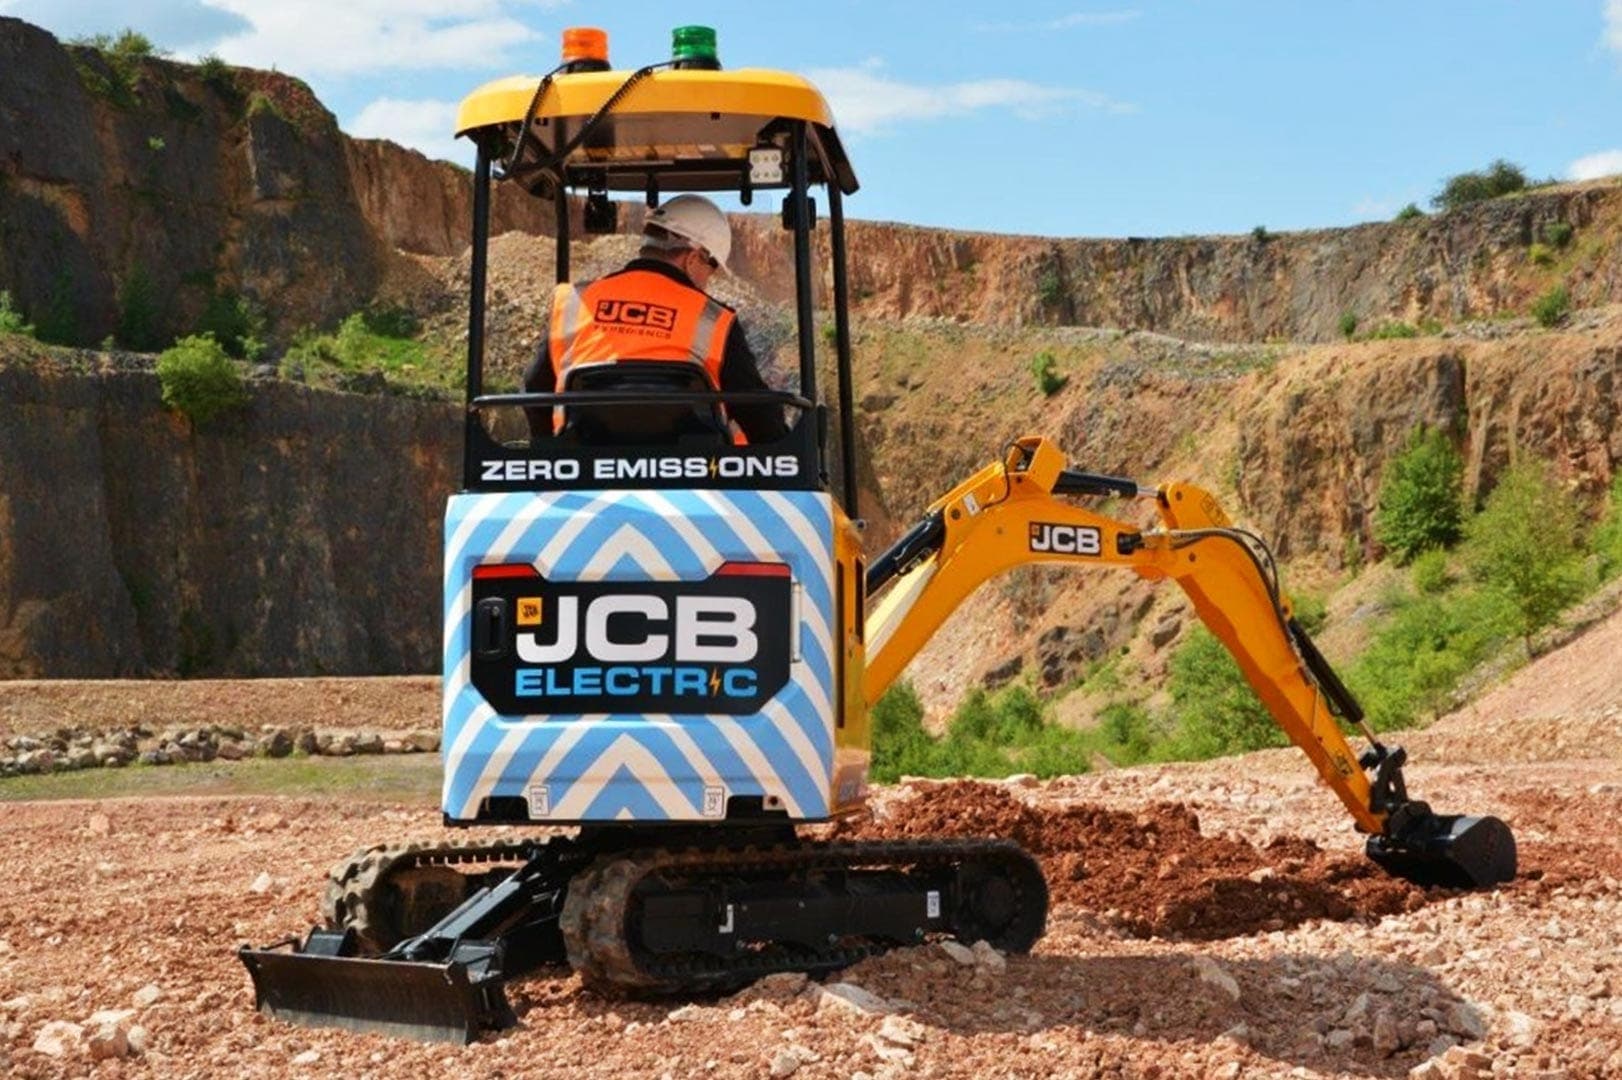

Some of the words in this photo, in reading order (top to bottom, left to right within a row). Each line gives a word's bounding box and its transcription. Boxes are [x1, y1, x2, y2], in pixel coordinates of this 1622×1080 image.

[597, 301, 674, 329] JCB
[481, 458, 580, 481] ZERO
[594, 455, 799, 479] EMISSIONS
[1031, 525, 1100, 554] JCB
[515, 595, 758, 664] JCB
[515, 666, 758, 698] ELECTRIC
